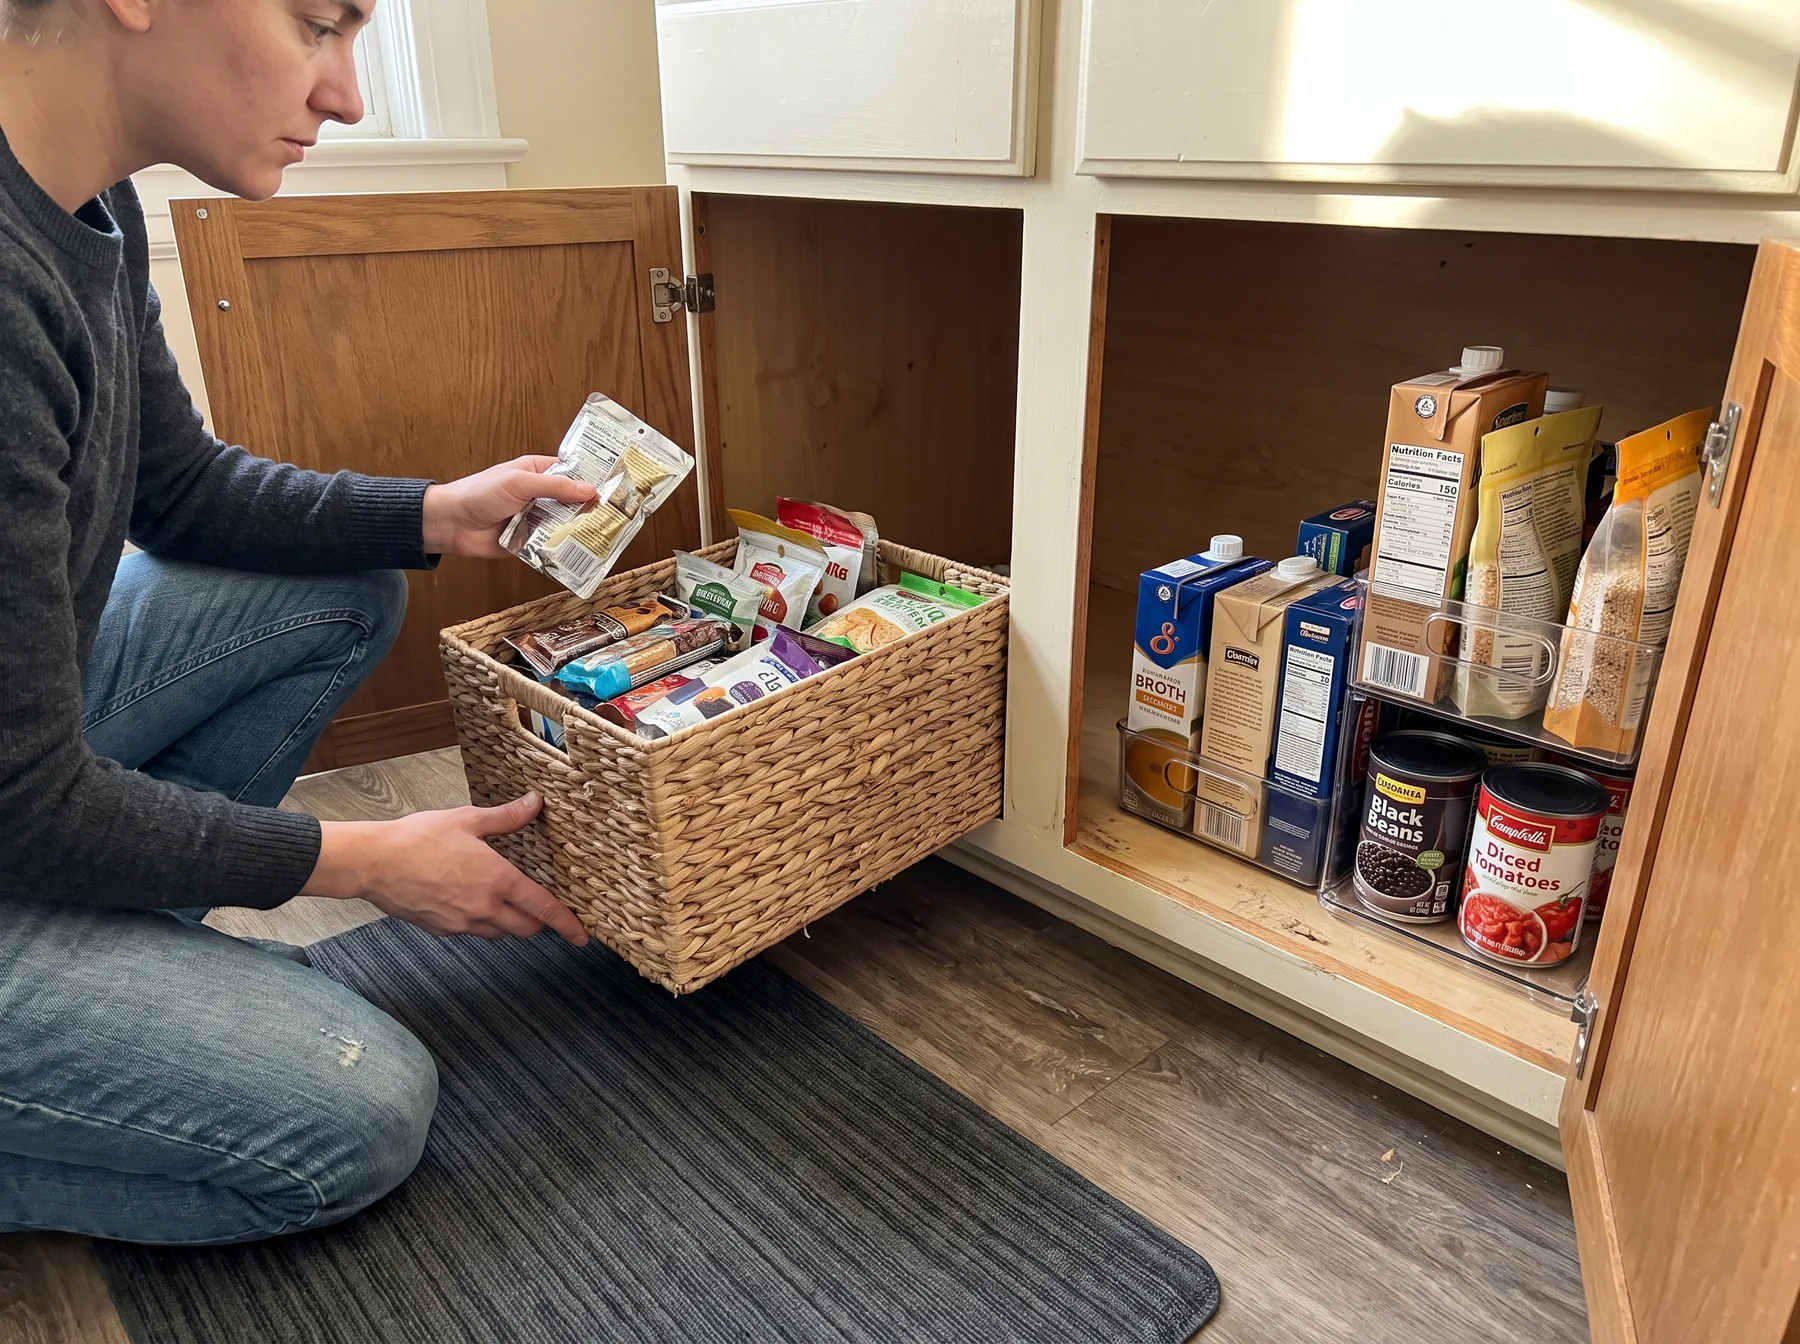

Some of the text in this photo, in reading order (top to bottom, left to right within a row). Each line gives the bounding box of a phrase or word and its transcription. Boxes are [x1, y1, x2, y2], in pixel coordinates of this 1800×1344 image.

[1391, 445, 1462, 463] Nutrition Facts
[1388, 478, 1457, 495] Calories 150
[1135, 673, 1186, 703] BROTH
[1367, 808, 1424, 843] Beans
[1371, 794, 1424, 827] Black
[1475, 848, 1561, 891] Tomatoes
[1487, 841, 1542, 873] Diced
